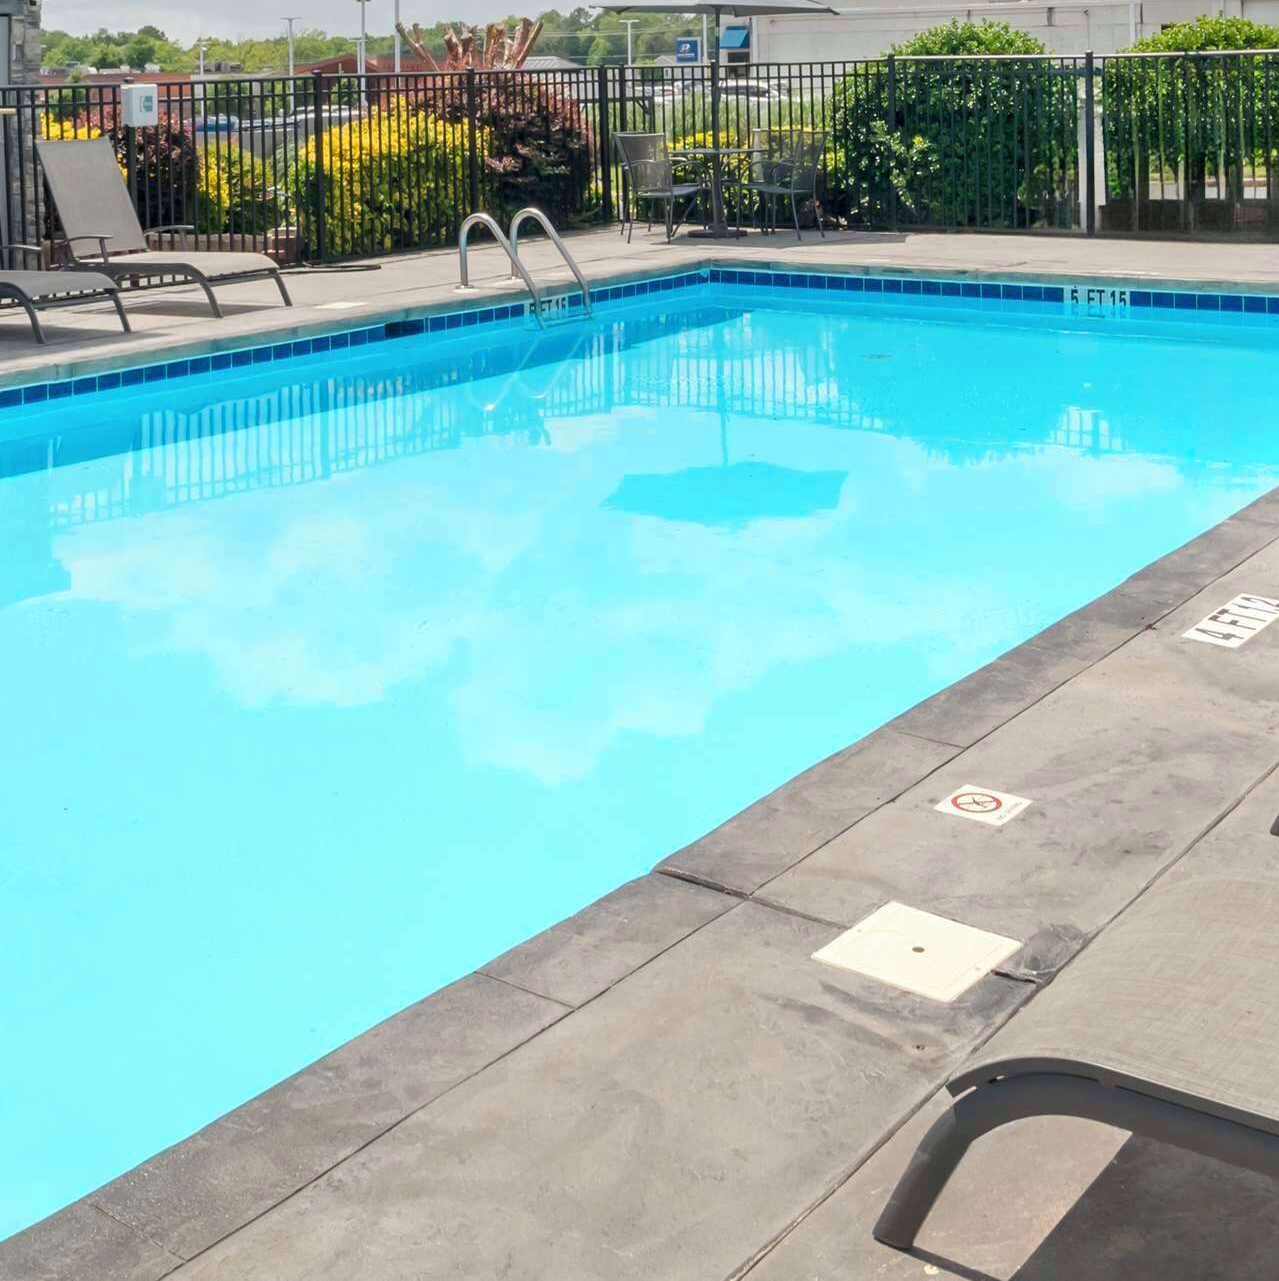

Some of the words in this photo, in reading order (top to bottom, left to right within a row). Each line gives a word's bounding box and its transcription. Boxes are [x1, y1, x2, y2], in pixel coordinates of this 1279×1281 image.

[1088, 289, 1105, 305] FT
[1207, 608, 1267, 630] FT
[1194, 627, 1245, 641] 4
